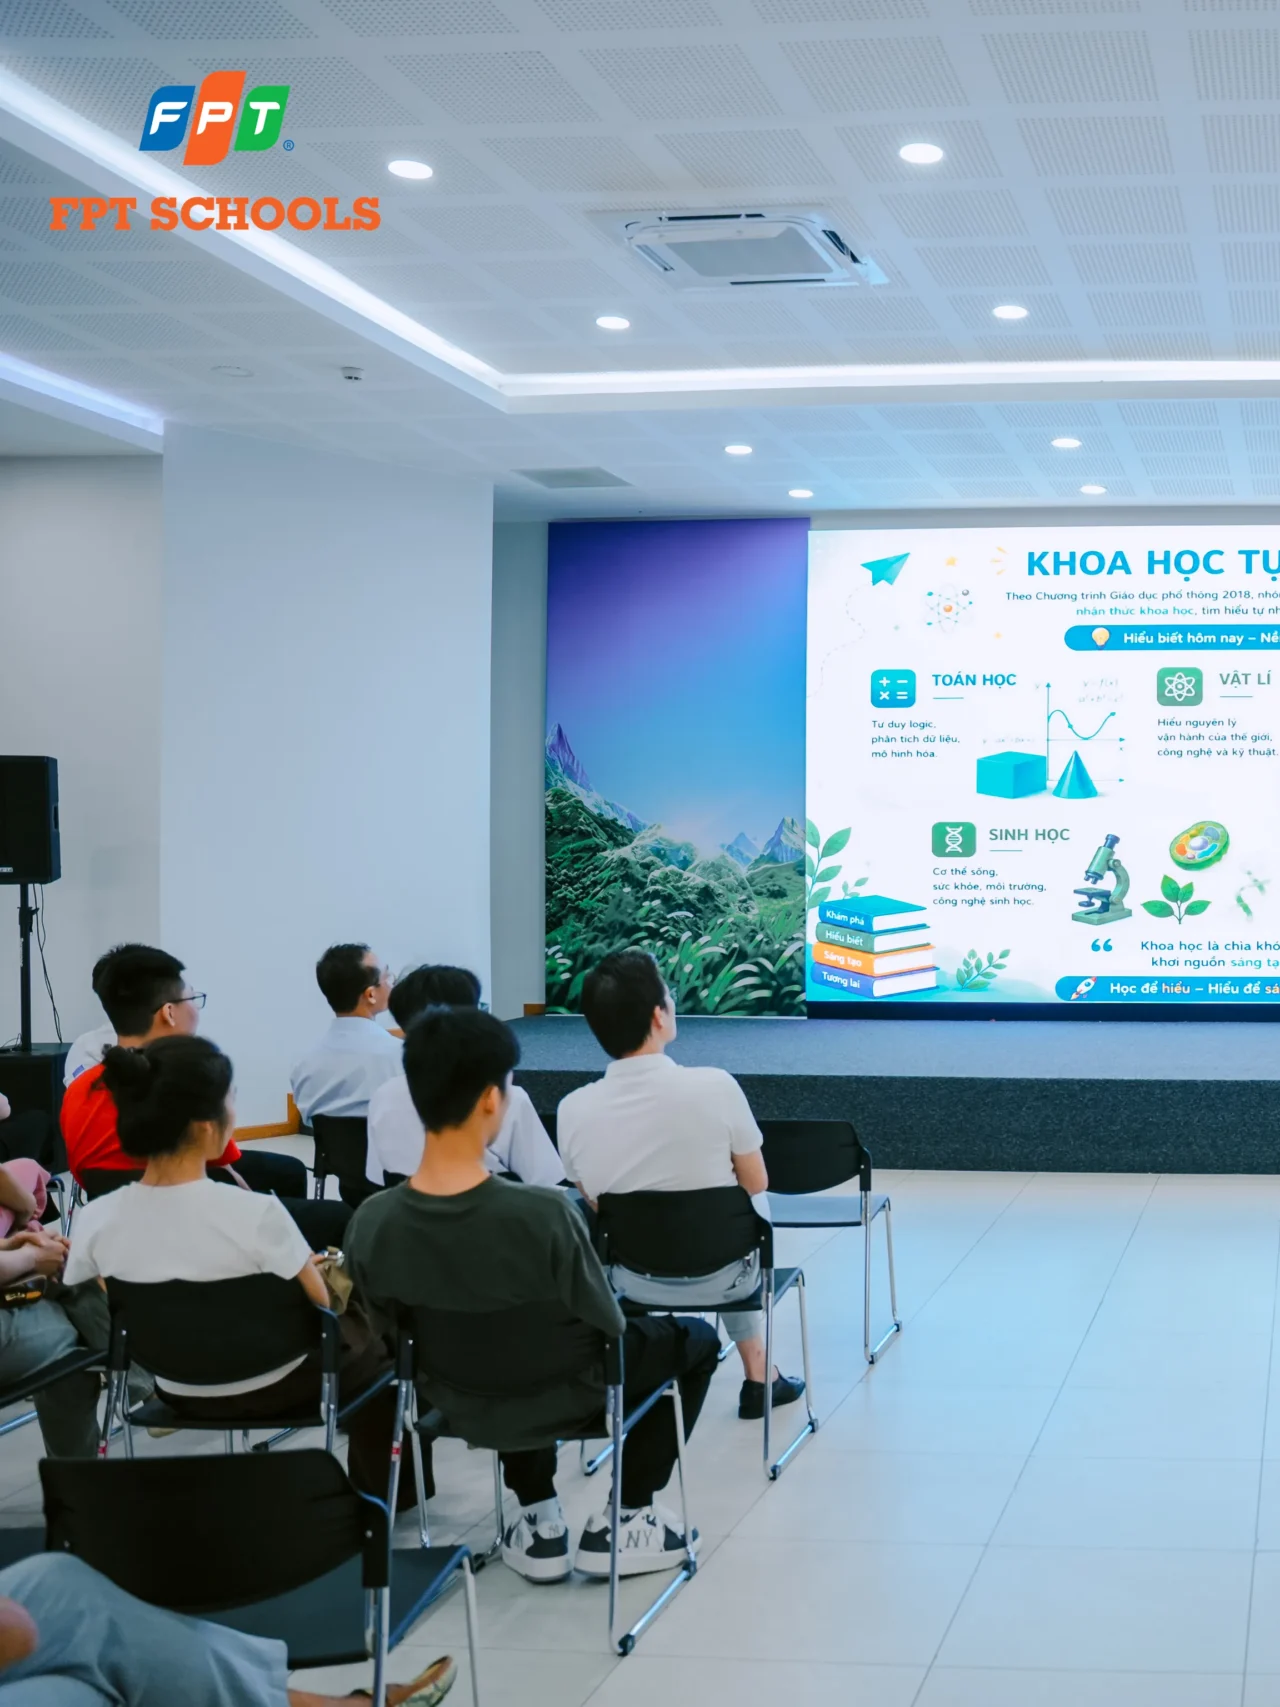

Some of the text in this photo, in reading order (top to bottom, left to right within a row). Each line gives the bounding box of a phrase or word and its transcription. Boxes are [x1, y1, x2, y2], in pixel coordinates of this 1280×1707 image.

[1028, 551, 1132, 576] KHOA
[1148, 550, 1225, 582] HỌC
[1123, 631, 1154, 644] Hiểu
[1158, 632, 1183, 643] biết
[1187, 632, 1217, 643] hôm
[1220, 635, 1244, 646] nay
[932, 671, 1016, 688] TOÁN HỌC
[1219, 670, 1271, 688] VẬT LÍ
[888, 721, 906, 730] duy
[910, 720, 936, 730] logic,
[989, 829, 1070, 844] SINH HỌC
[826, 909, 865, 926] Khám phá
[825, 929, 863, 946] Hiểu biết
[1141, 941, 1173, 950] Khoa
[1179, 941, 1202, 952] học
[1208, 941, 1219, 950] là
[1224, 941, 1251, 950] chìa
[1152, 957, 1179, 966] khơi
[1185, 956, 1225, 969] nguồn
[1231, 957, 1262, 969] sáng
[822, 971, 861, 989] Tương lai
[1110, 983, 1136, 996] Học
[1141, 981, 1158, 994] để
[1161, 981, 1191, 994] hiểu
[1208, 981, 1240, 994] Hiểu
[1243, 981, 1261, 994] để
[625, 1530, 652, 1548] NY
